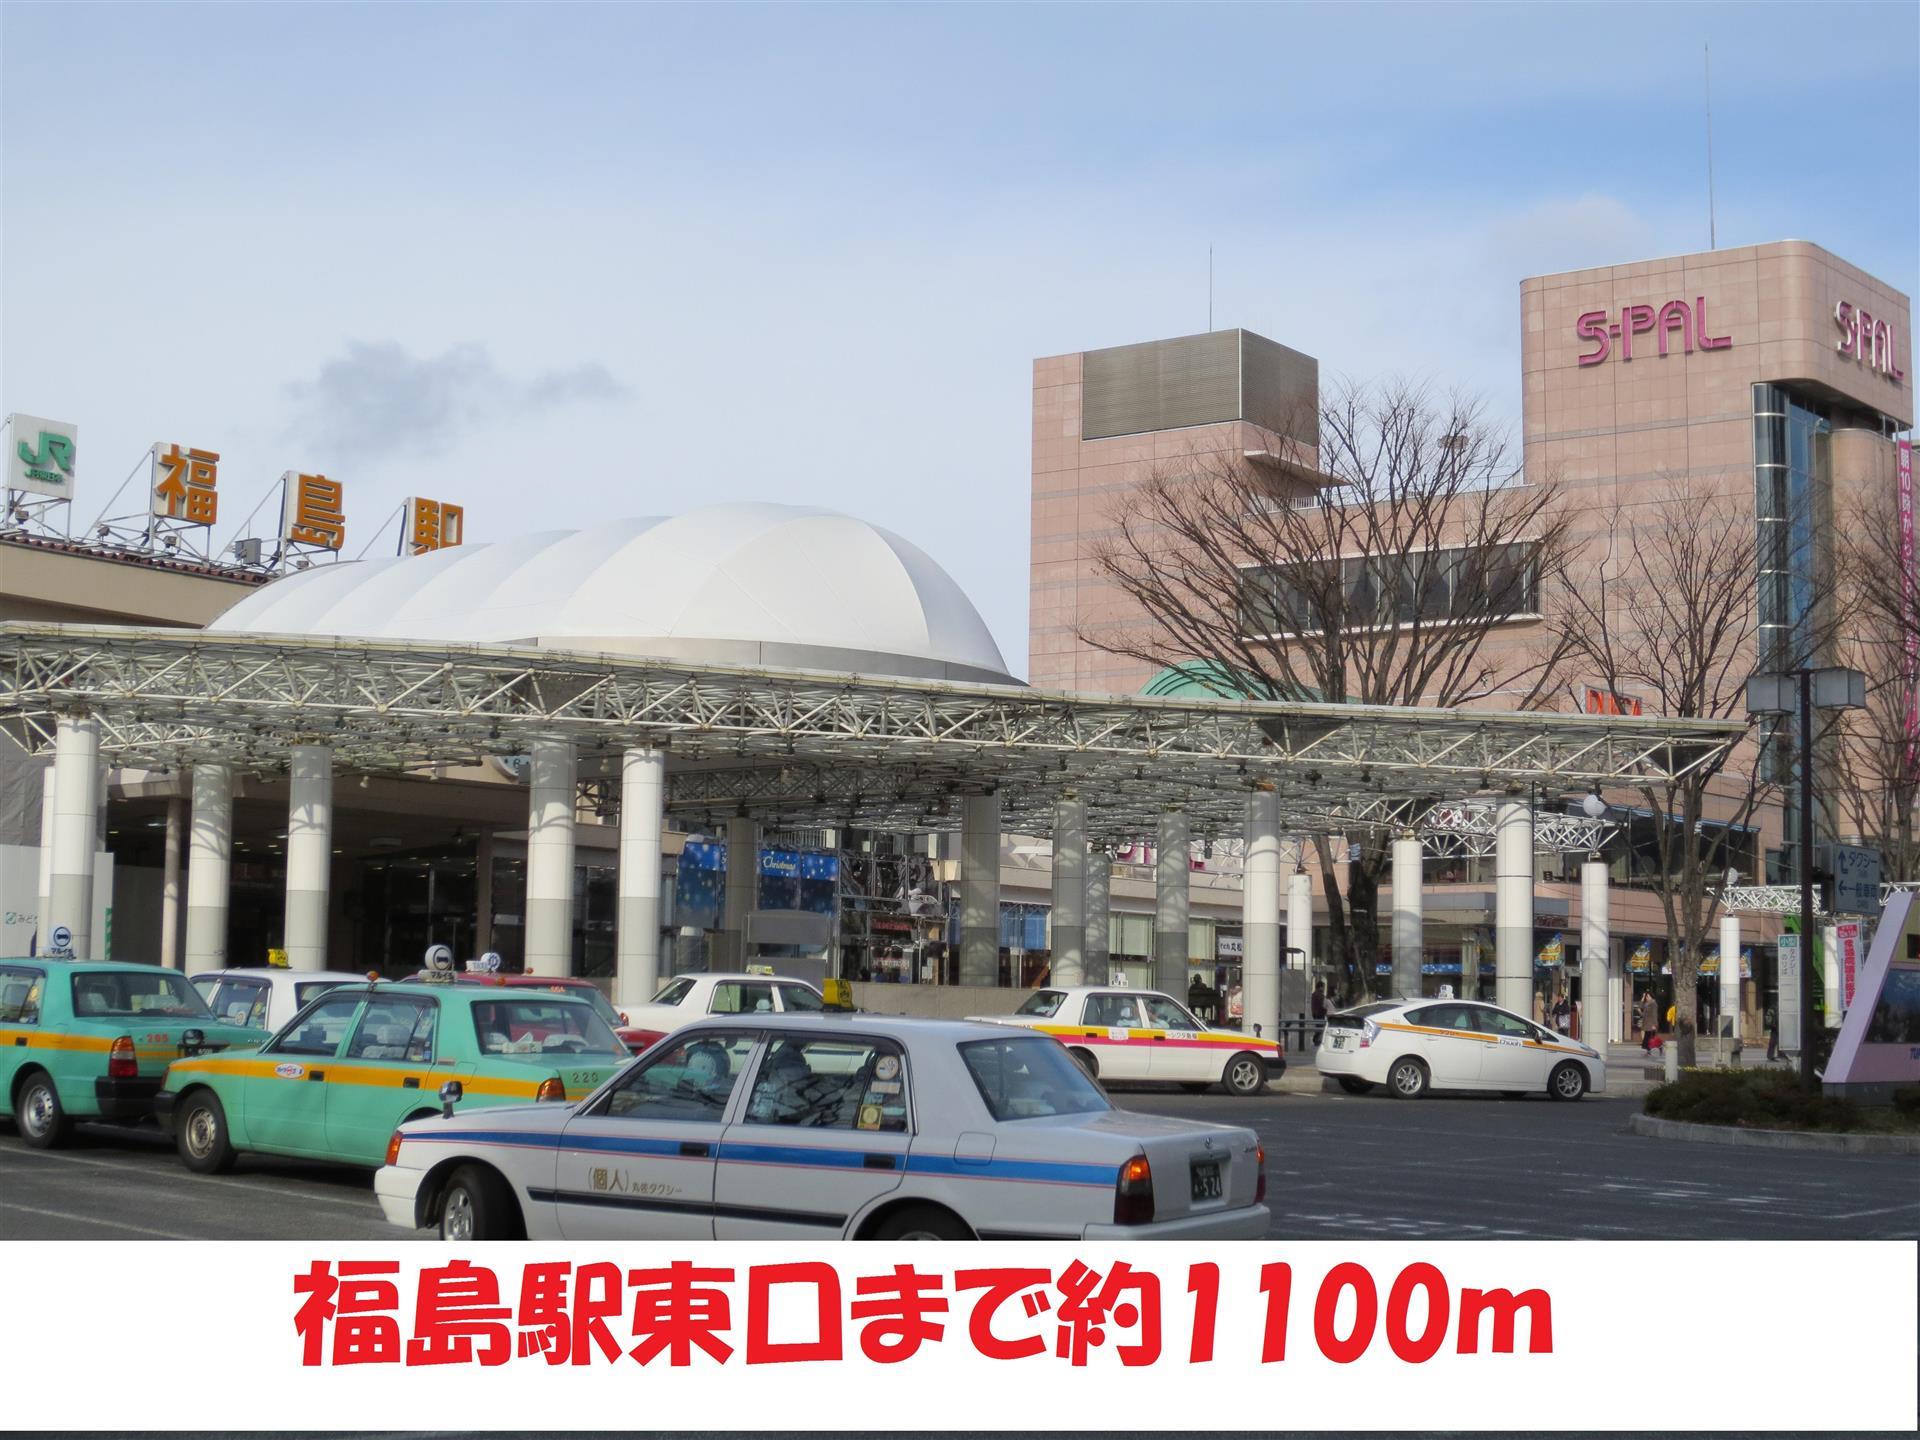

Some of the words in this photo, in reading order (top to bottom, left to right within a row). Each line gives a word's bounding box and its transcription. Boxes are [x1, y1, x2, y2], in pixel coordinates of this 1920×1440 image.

[1576, 297, 1732, 367] S-PAL
[1833, 301, 1904, 381] S-PAL
[17, 431, 74, 471] JR
[763, 856, 796, 870] Christmas
